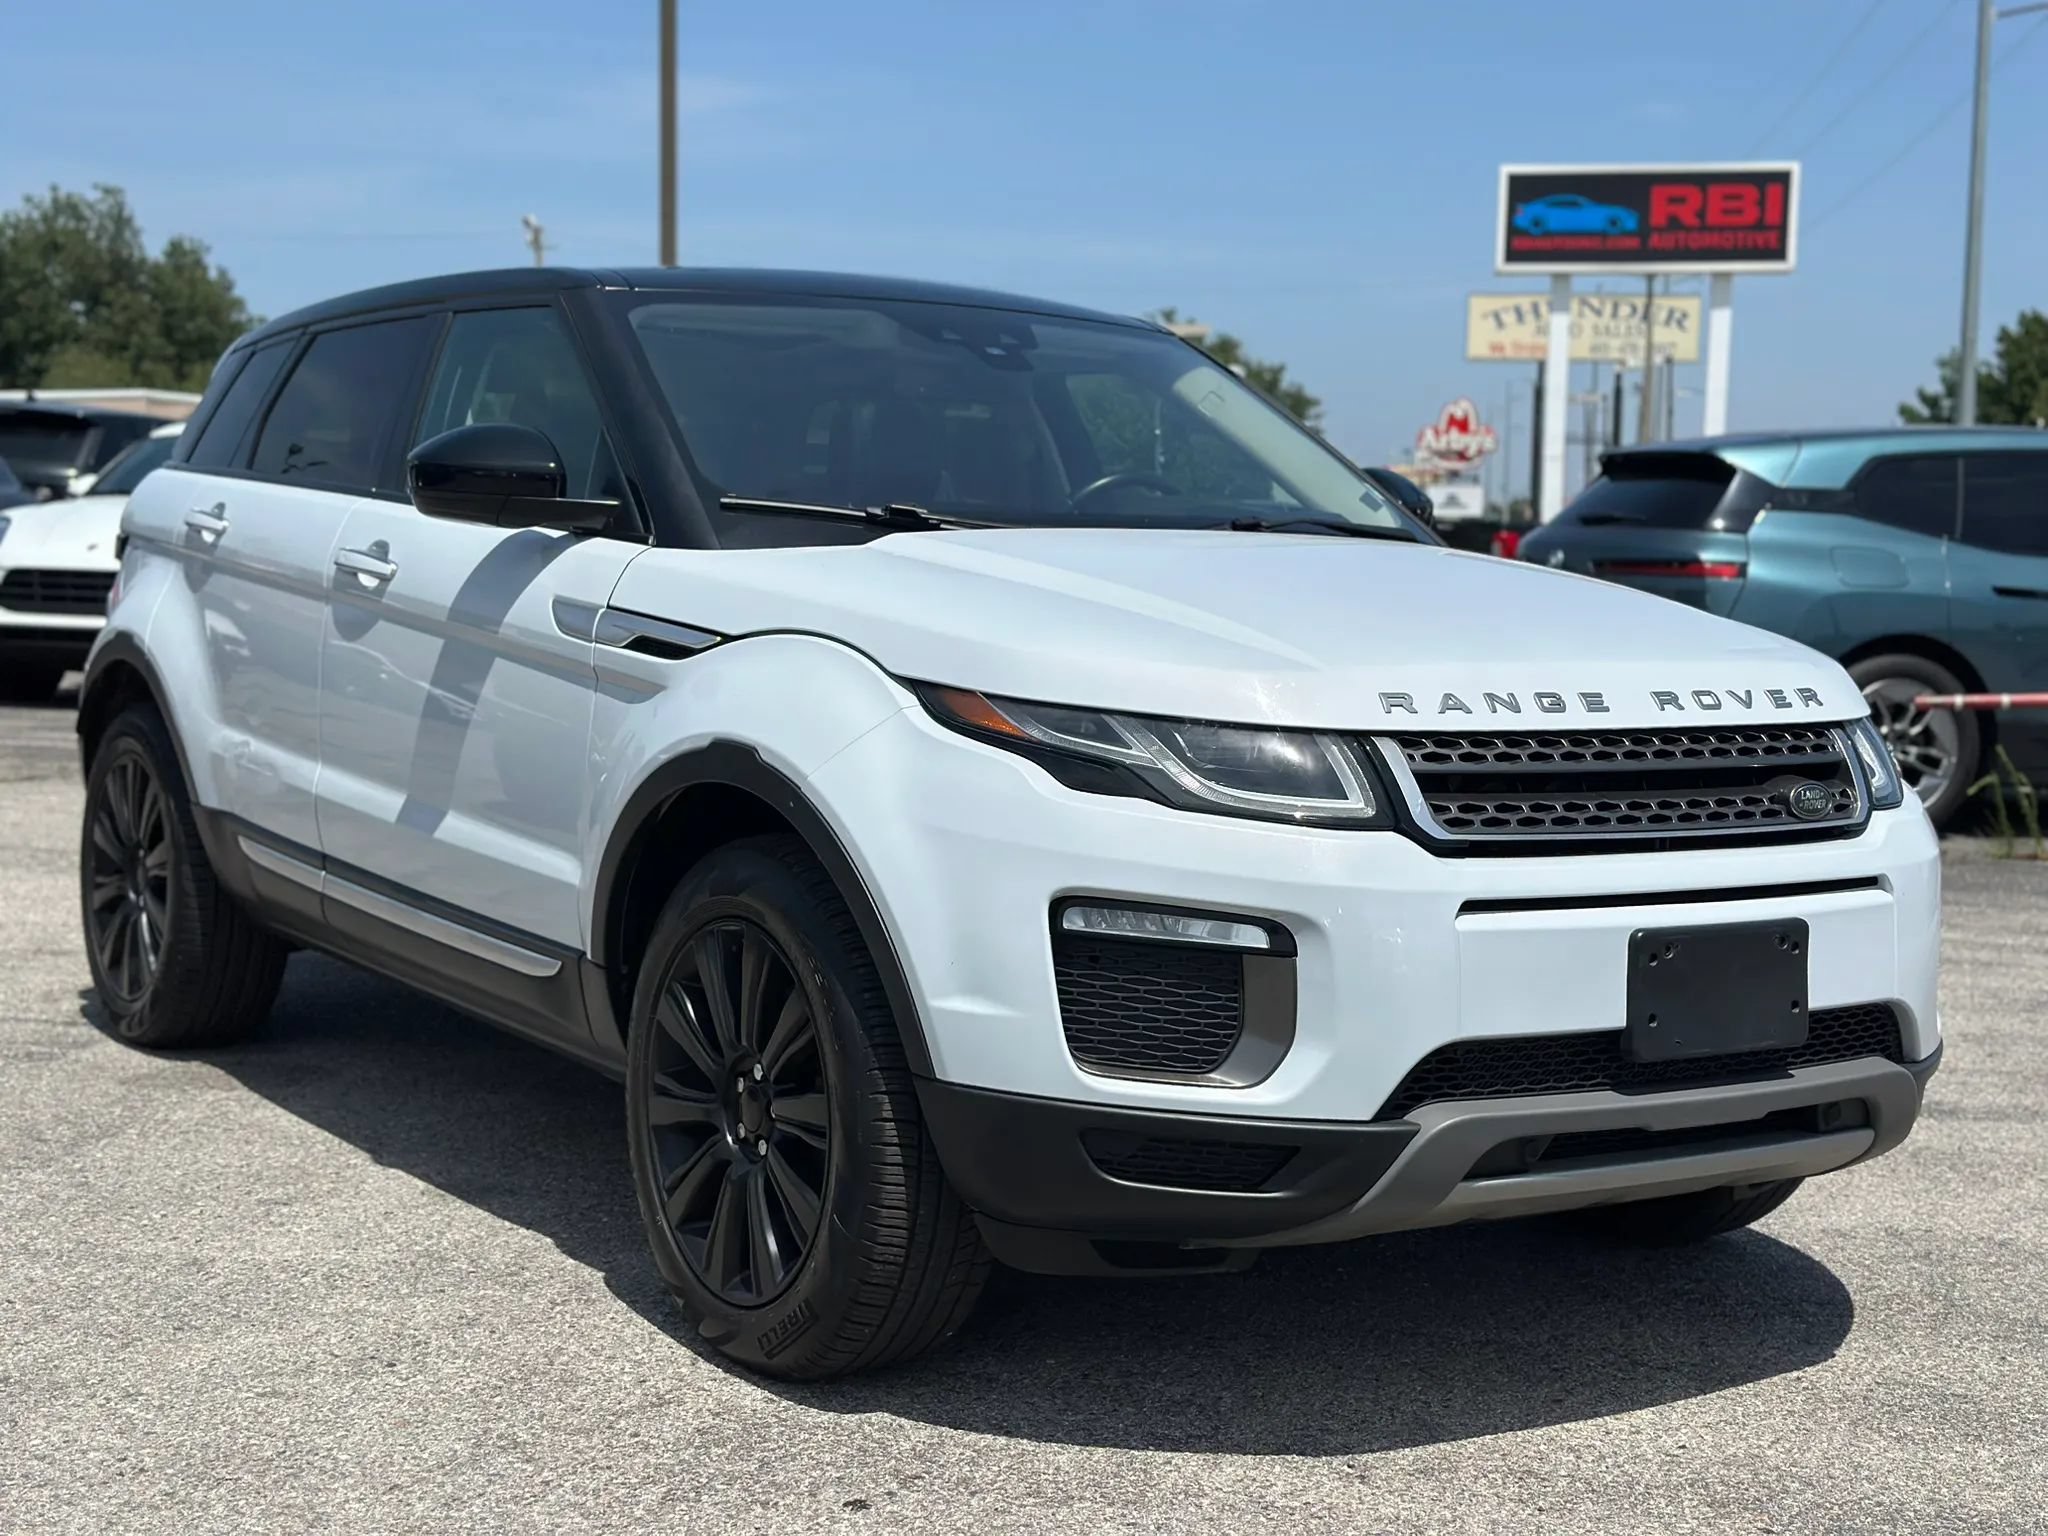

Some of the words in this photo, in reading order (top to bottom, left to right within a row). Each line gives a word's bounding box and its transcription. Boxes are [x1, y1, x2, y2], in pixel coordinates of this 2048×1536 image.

[1650, 183, 1784, 228] RBI
[1648, 231, 1780, 249] AUTOMOTIVE
[1378, 691, 1611, 714] RANGE
[1650, 687, 1824, 711] ROVER
[1801, 789, 1821, 800] LAND
[1804, 799, 1827, 810] ROVER
